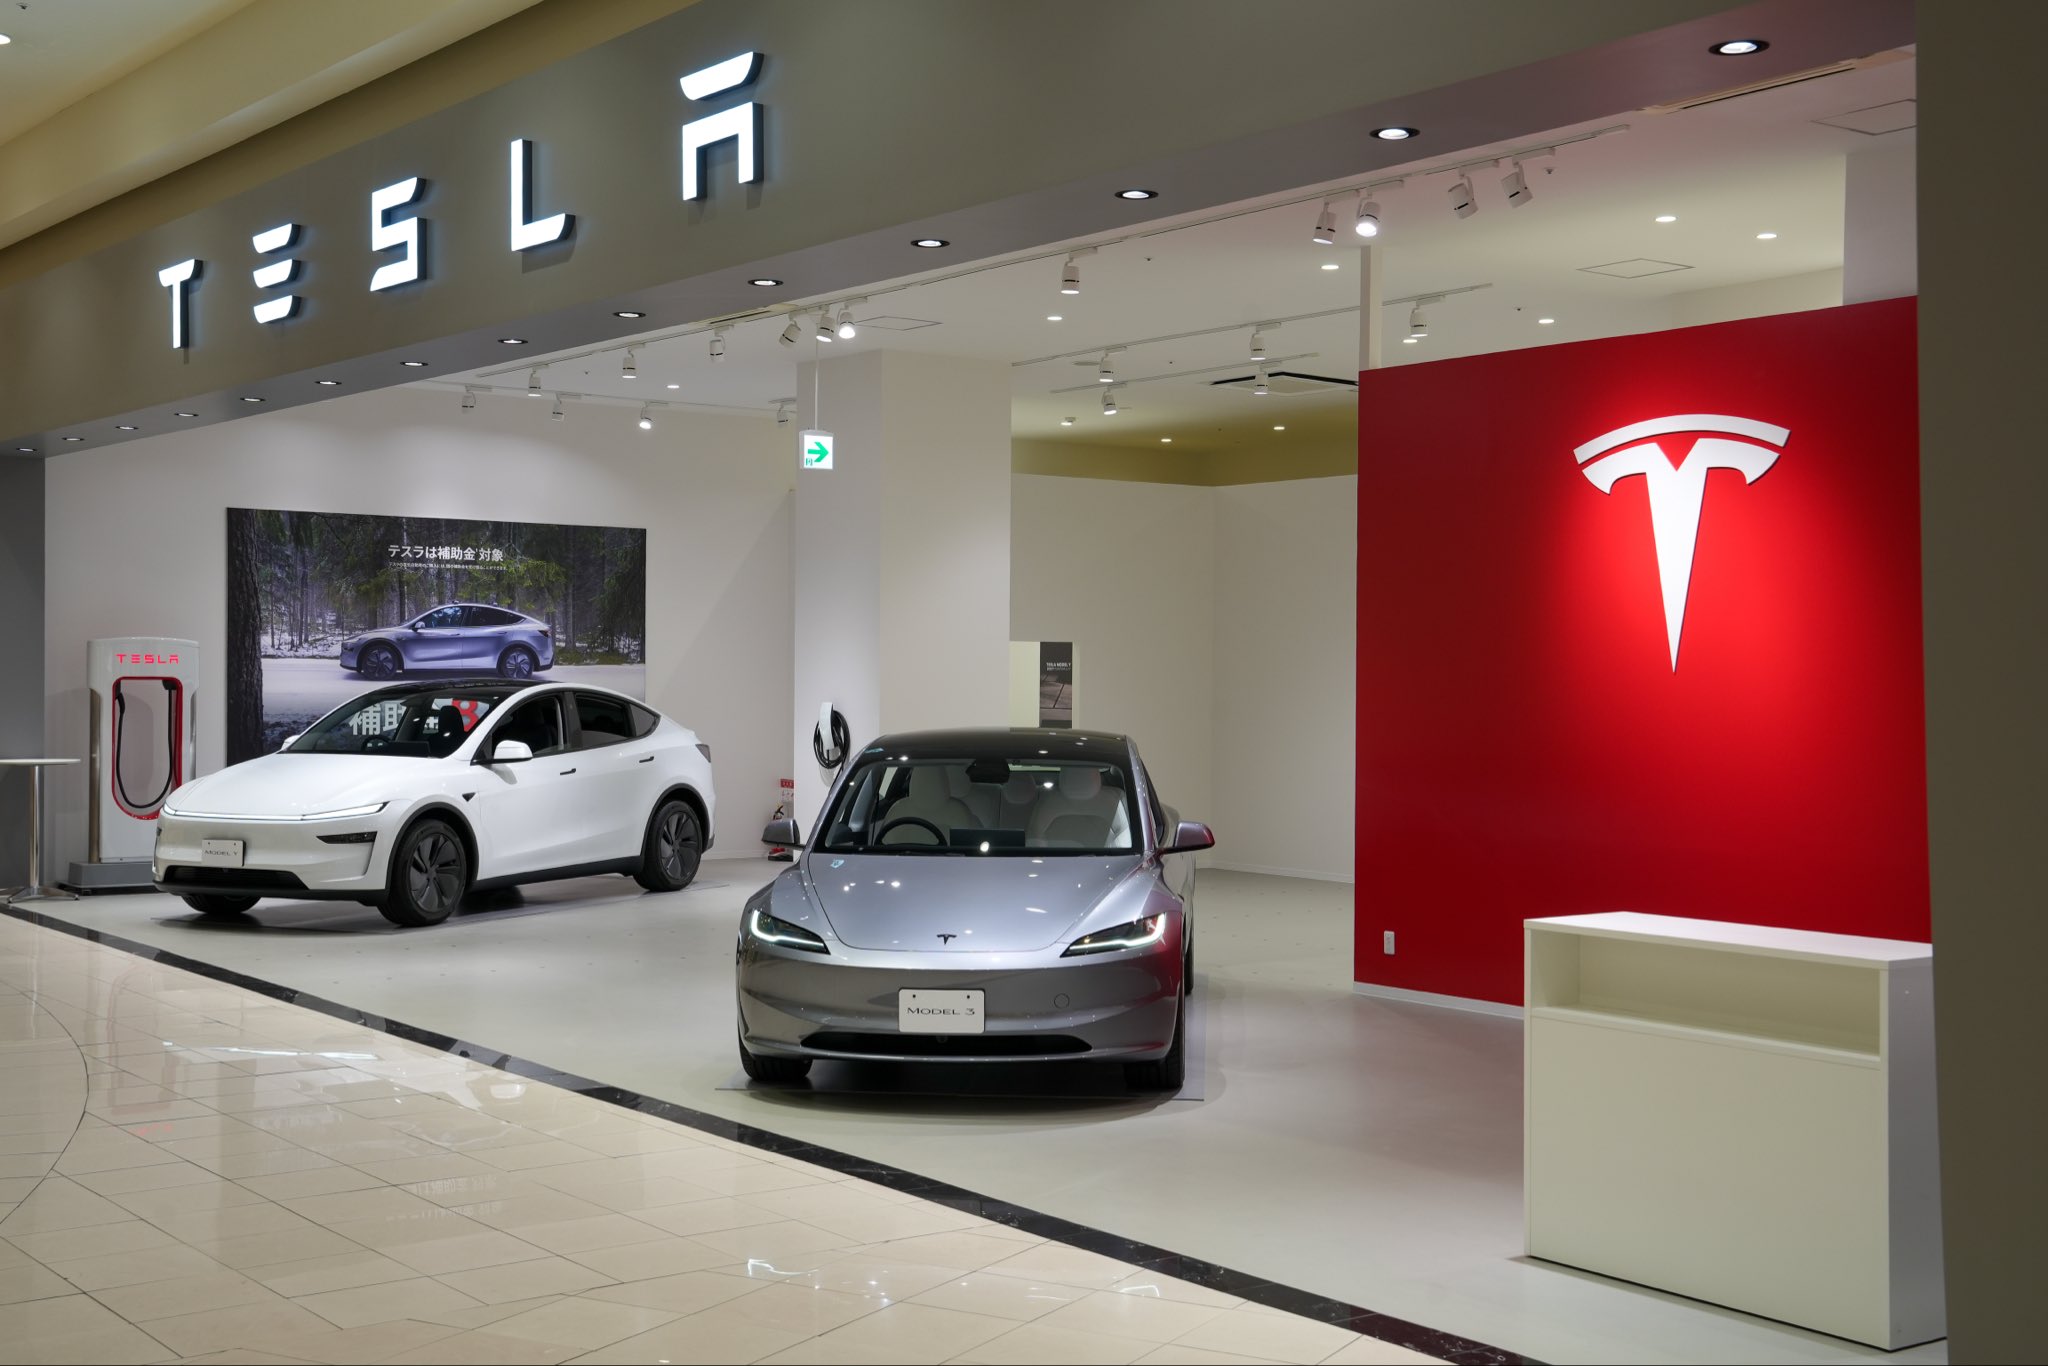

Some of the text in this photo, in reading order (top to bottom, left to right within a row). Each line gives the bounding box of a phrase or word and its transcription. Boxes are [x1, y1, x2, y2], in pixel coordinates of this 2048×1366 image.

[158, 51, 764, 349] TESLA
[115, 653, 179, 664] TESLA
[907, 1007, 960, 1015] MODEL
